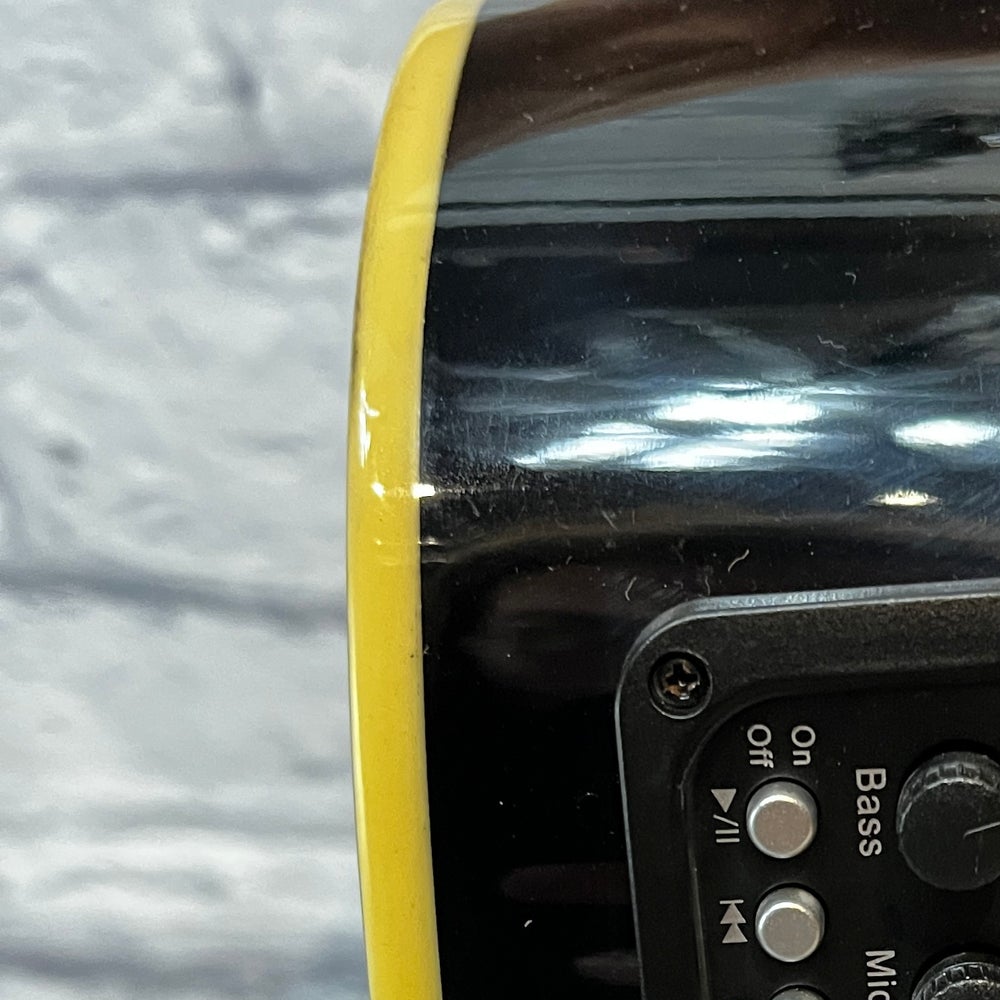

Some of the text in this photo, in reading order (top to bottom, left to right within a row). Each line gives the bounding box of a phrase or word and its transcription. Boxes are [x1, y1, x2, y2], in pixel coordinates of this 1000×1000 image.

[747, 724, 775, 769] Off
[791, 725, 816, 766] On
[855, 768, 887, 857] Bass
